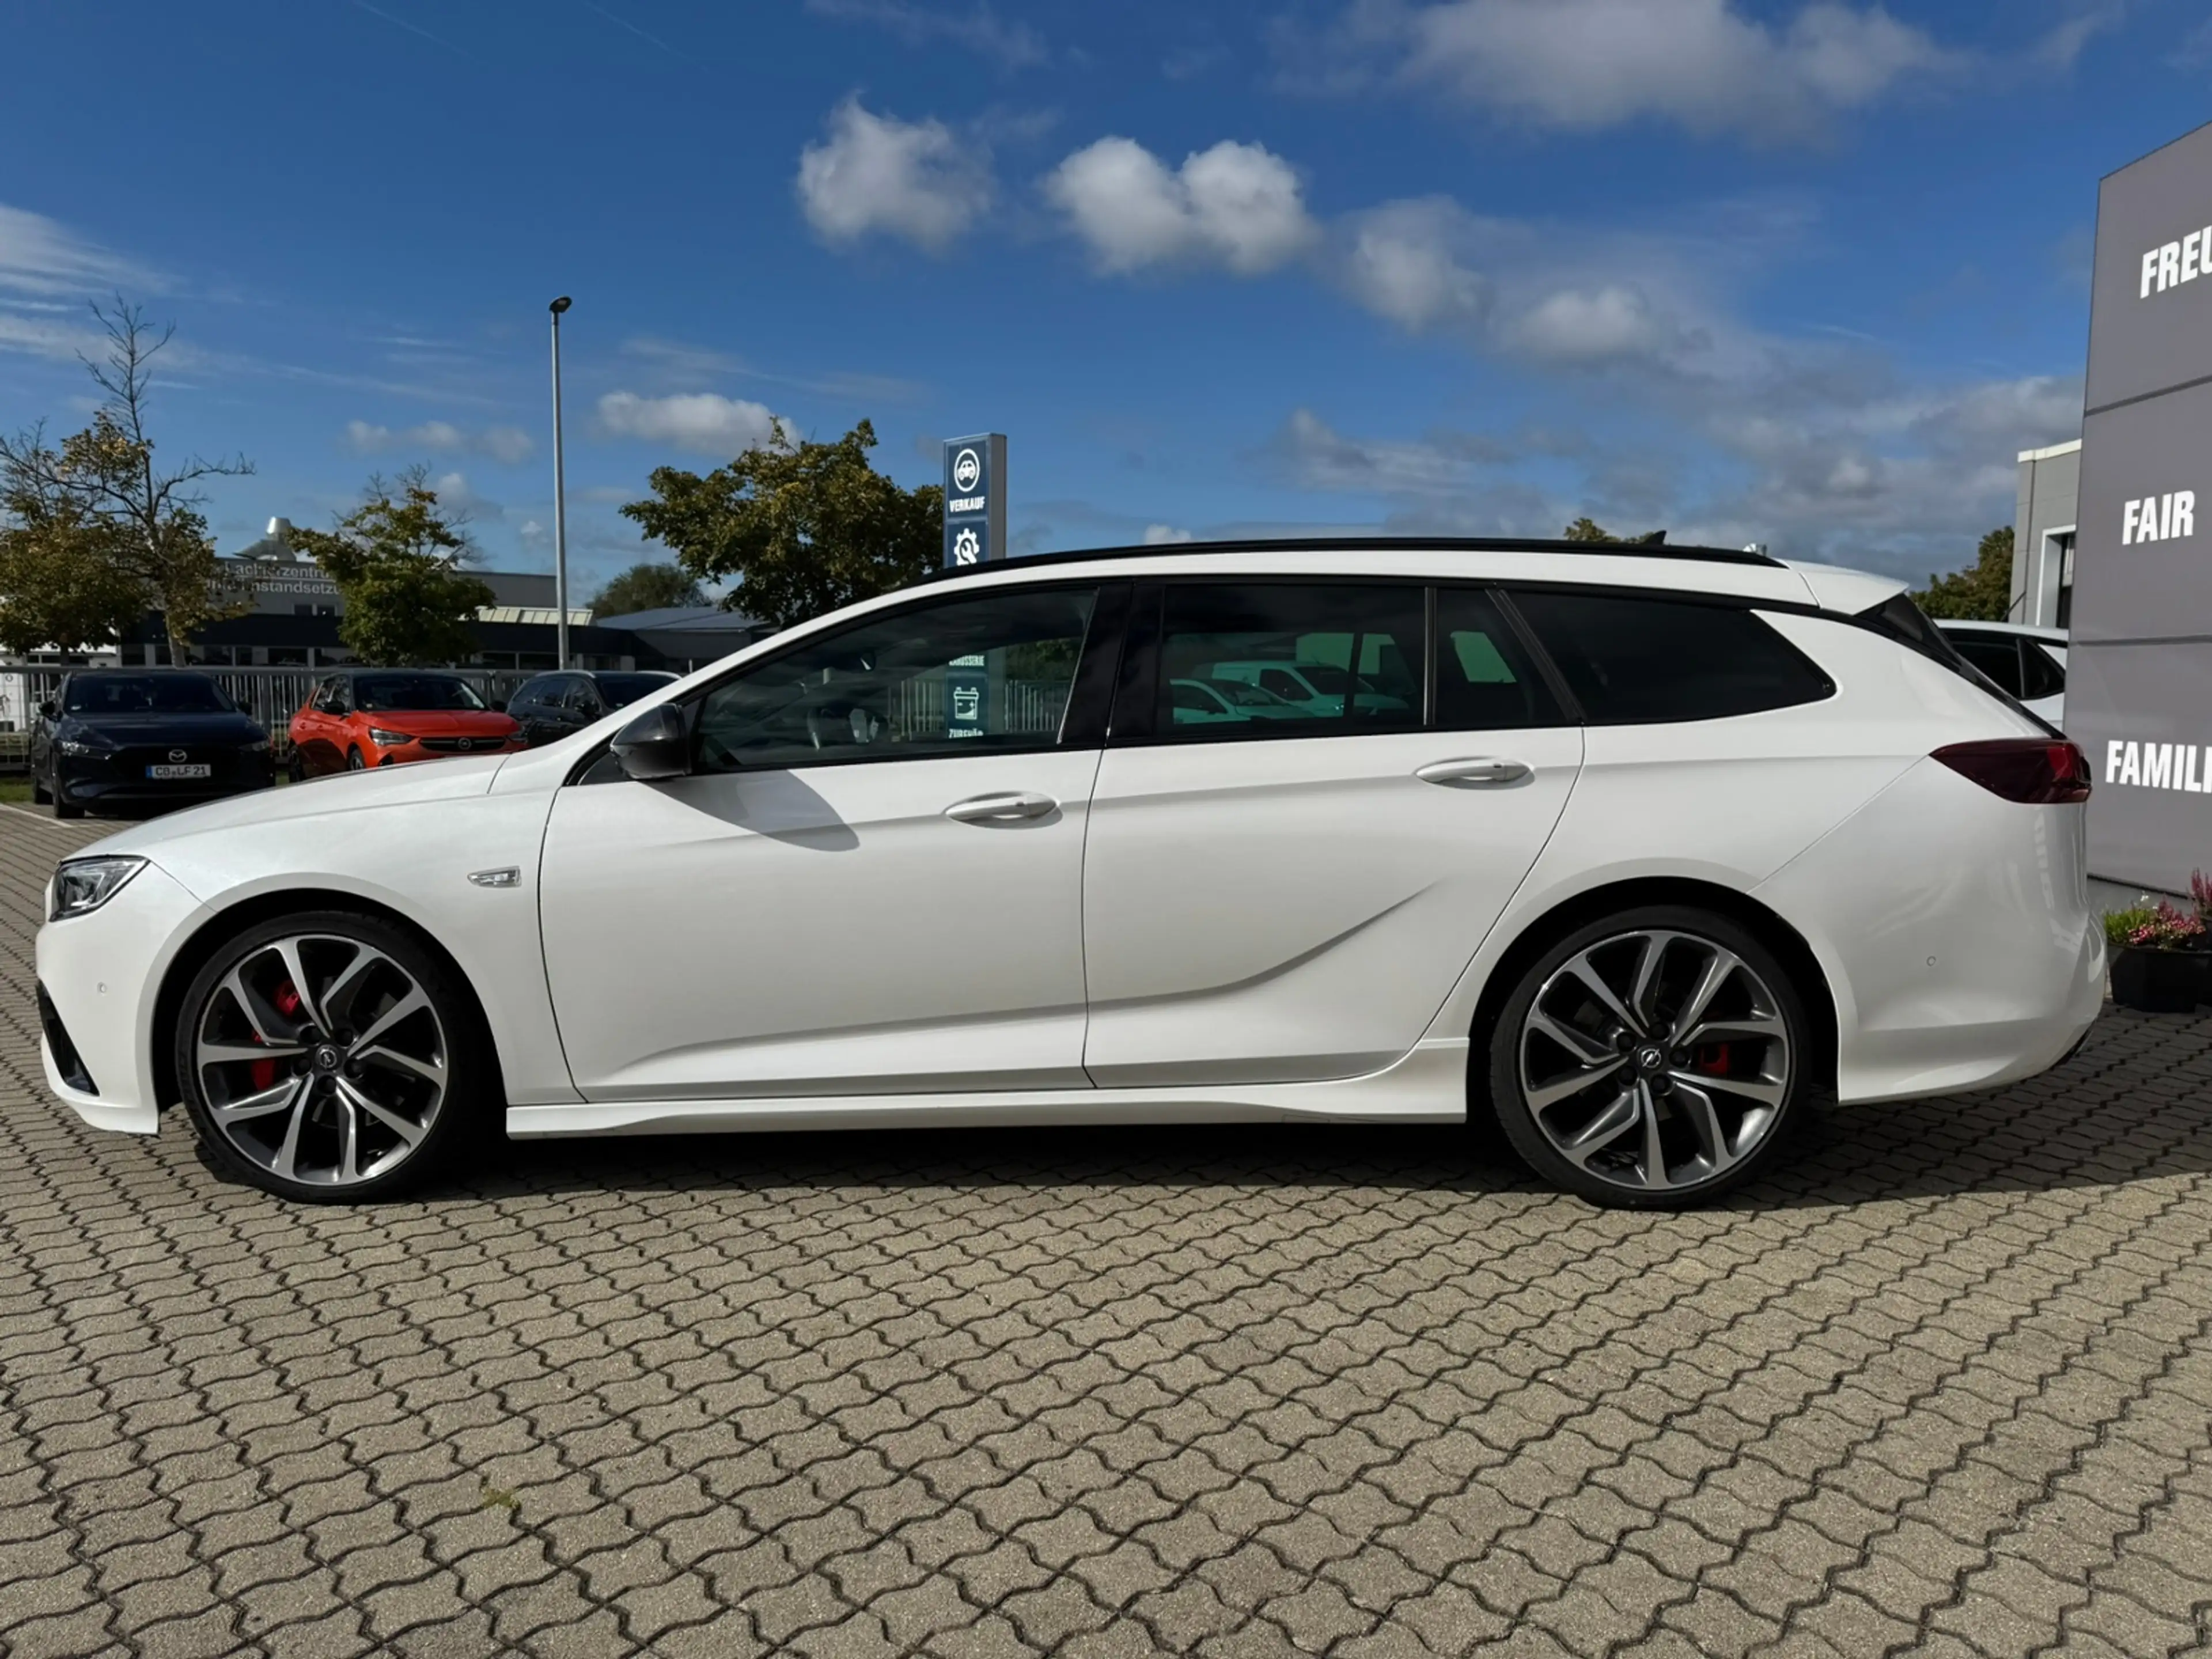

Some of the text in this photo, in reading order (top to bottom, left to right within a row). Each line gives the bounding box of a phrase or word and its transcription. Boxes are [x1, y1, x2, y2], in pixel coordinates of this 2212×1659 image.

[949, 496, 985, 512] VERKAUF
[2122, 490, 2195, 546] FAIR
[193, 766, 206, 775] 21
